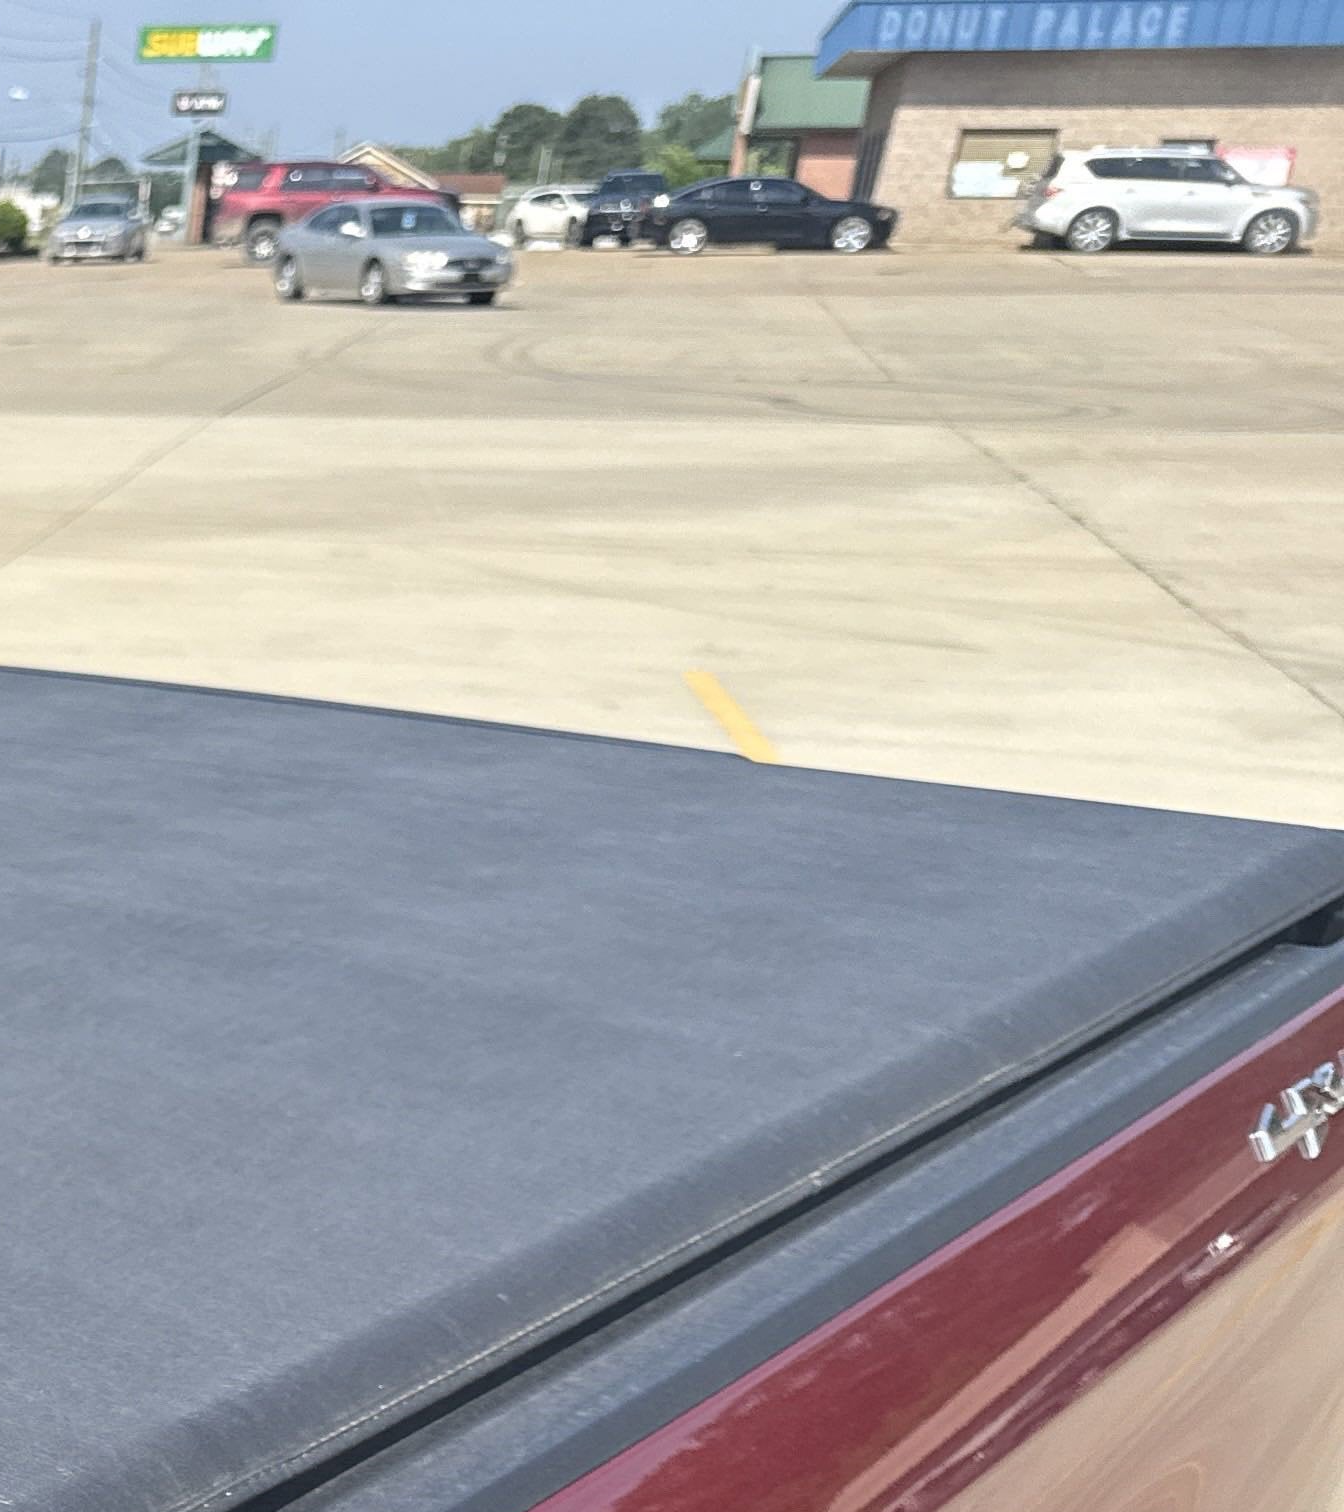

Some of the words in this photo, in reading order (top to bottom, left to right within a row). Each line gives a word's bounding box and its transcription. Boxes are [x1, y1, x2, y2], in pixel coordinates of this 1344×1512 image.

[142, 28, 272, 58] SUBWAY
[878, 8, 1008, 44] DONUT
[1031, 6, 1191, 44] PALACE
[1248, 1049, 1344, 1162] 4X
